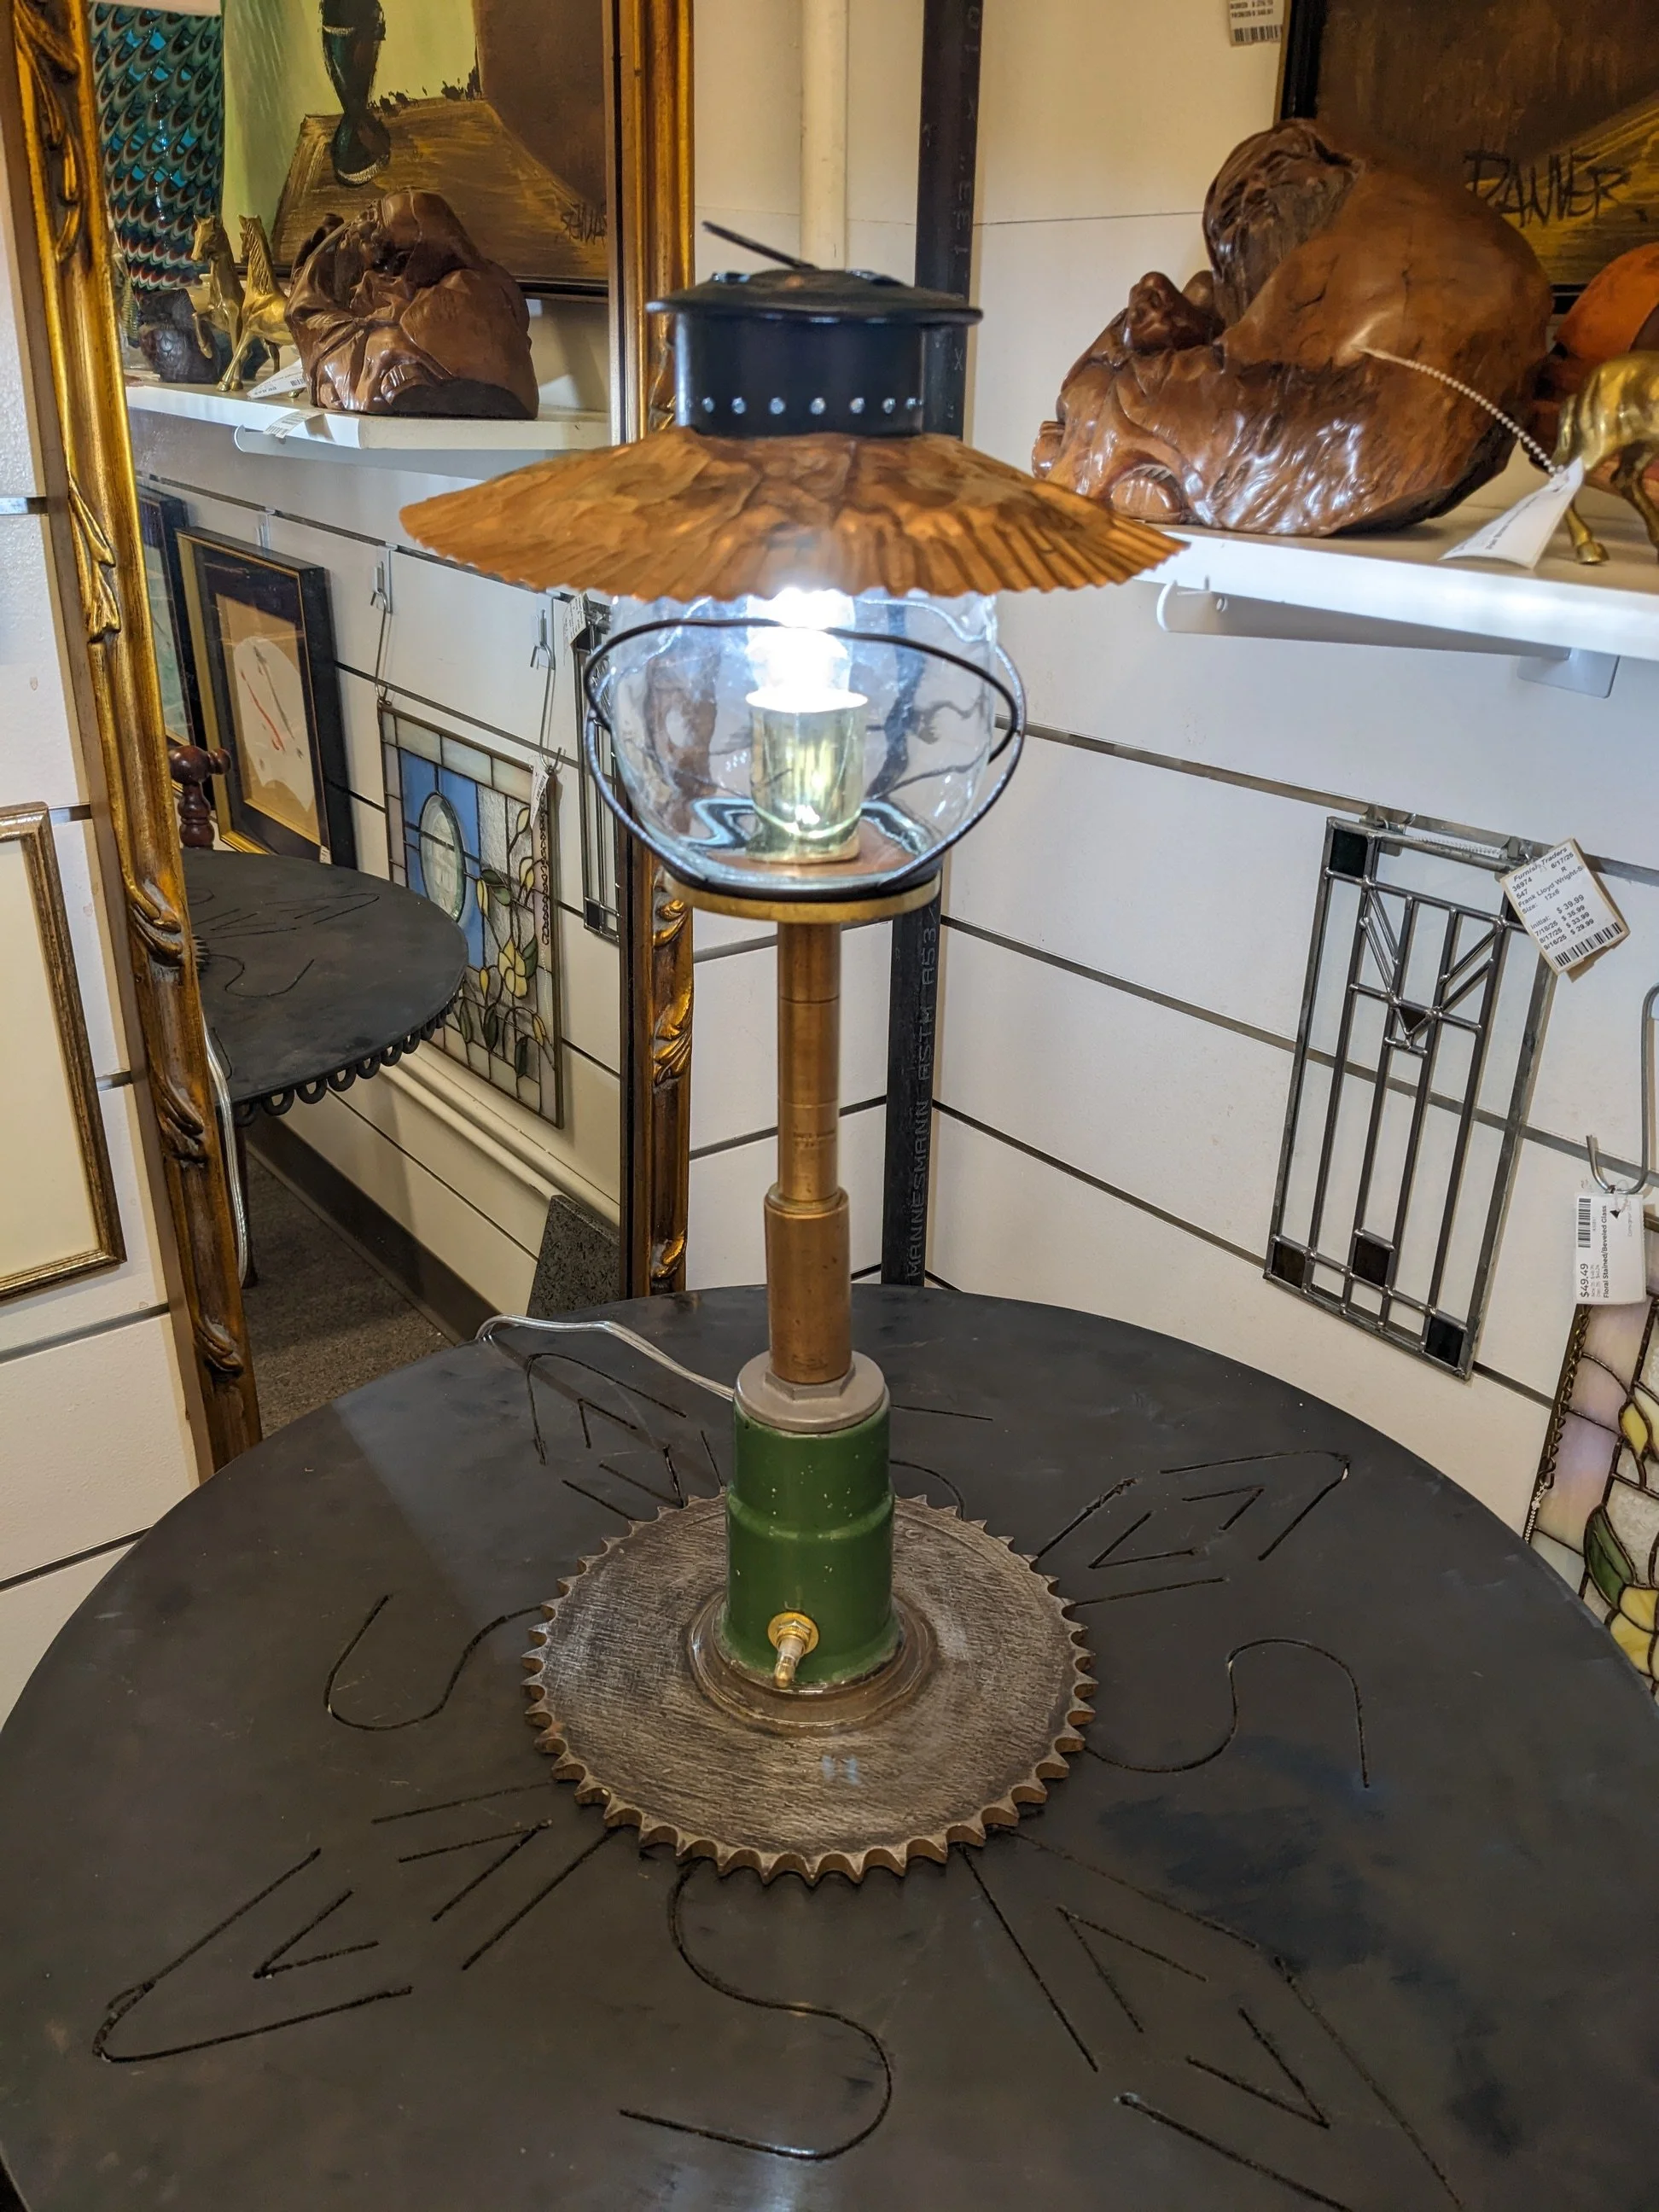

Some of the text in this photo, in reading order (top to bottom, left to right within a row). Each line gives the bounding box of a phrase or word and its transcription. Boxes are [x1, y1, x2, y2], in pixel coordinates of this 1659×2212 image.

[1541, 847, 1568, 866] Traders
[1511, 876, 1533, 892] 36974
[1516, 888, 1528, 899] 547
[1517, 894, 1536, 909] Frank
[1536, 882, 1555, 897] Lloyd
[1522, 902, 1539, 914] Size:
[1530, 915, 1551, 929] Initial:
[1563, 894, 1585, 910] 39.99
[1571, 911, 1590, 925] 33.99
[1575, 917, 1595, 932] 29.99
[905, 1099, 929, 1278] MANNESMANN
[917, 1005, 935, 1081] ASTM
[1600, 1225, 1609, 1279] Stained/Beveled
[1580, 1263, 1590, 1298] $49.49
